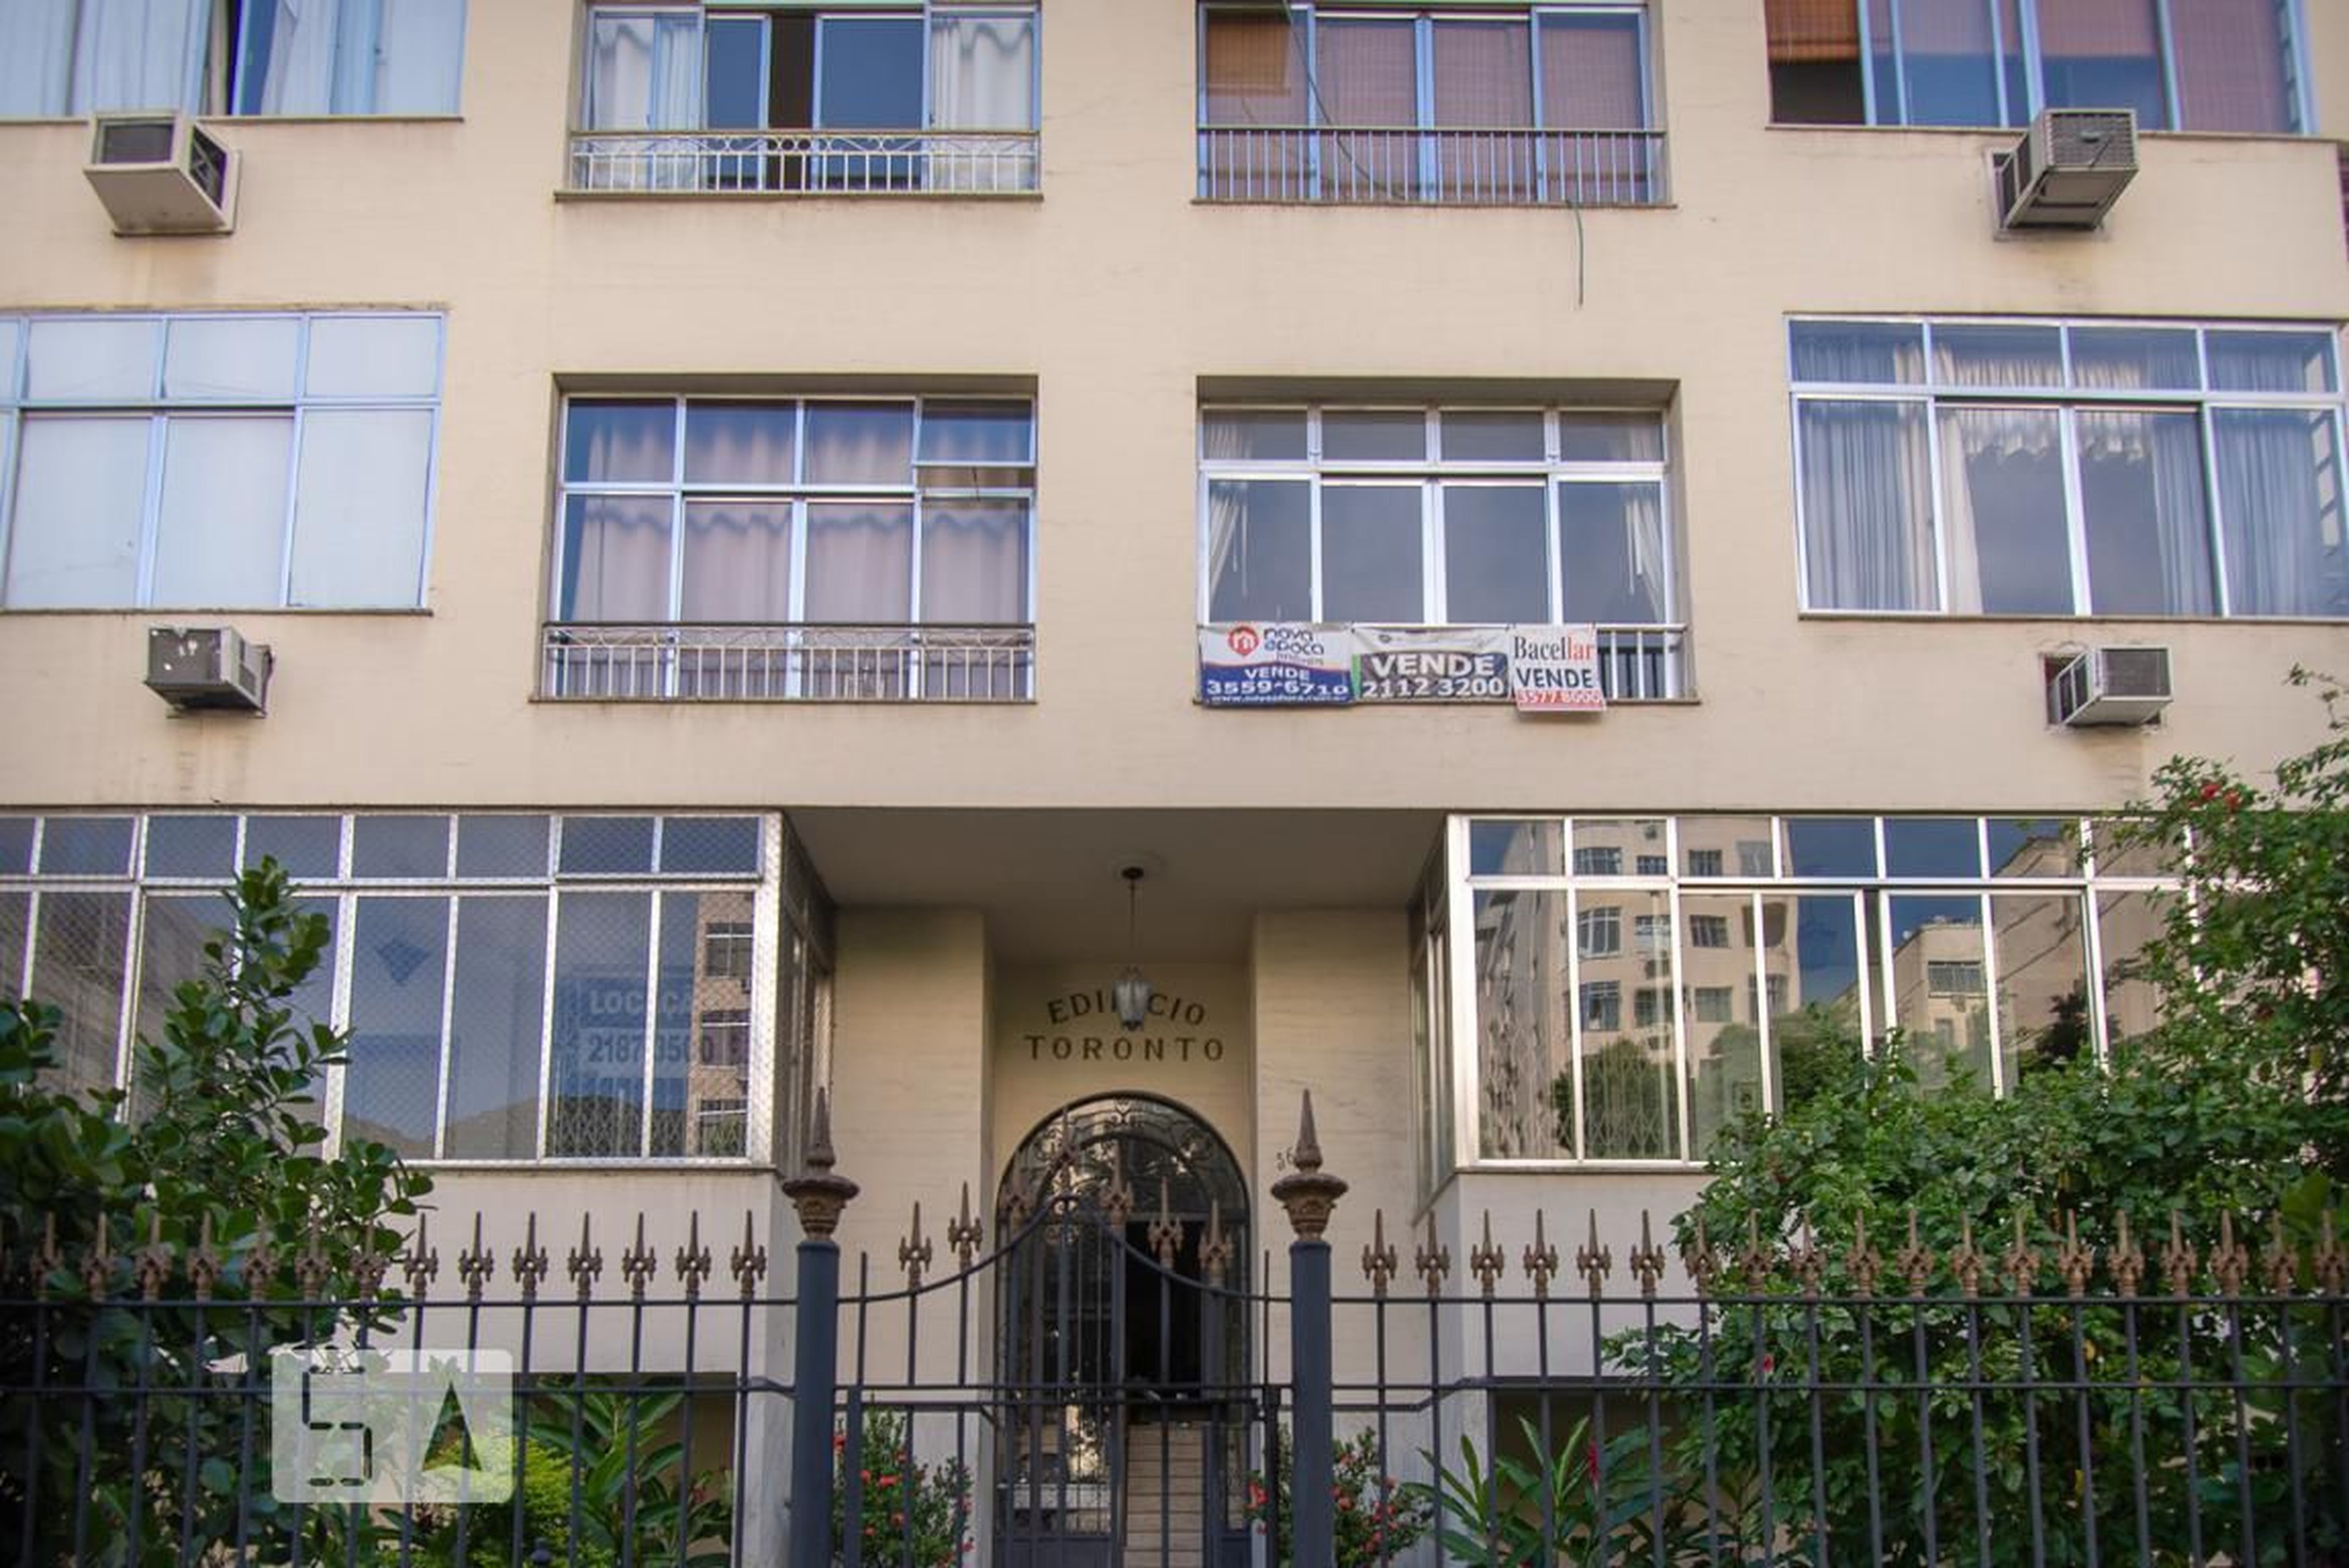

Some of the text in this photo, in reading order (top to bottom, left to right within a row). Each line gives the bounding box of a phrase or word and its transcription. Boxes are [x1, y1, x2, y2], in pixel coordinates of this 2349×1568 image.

[1264, 628, 1313, 642] nova
[1514, 637, 1594, 660] Bacellar
[1244, 667, 1310, 681] VENDE
[1371, 654, 1494, 677] VENDE
[1362, 677, 1504, 698] 2112 3200
[1516, 668, 1594, 689] VENDE
[1047, 989, 1205, 1026] EDICIO
[1024, 1035, 1223, 1061] TORONTO
